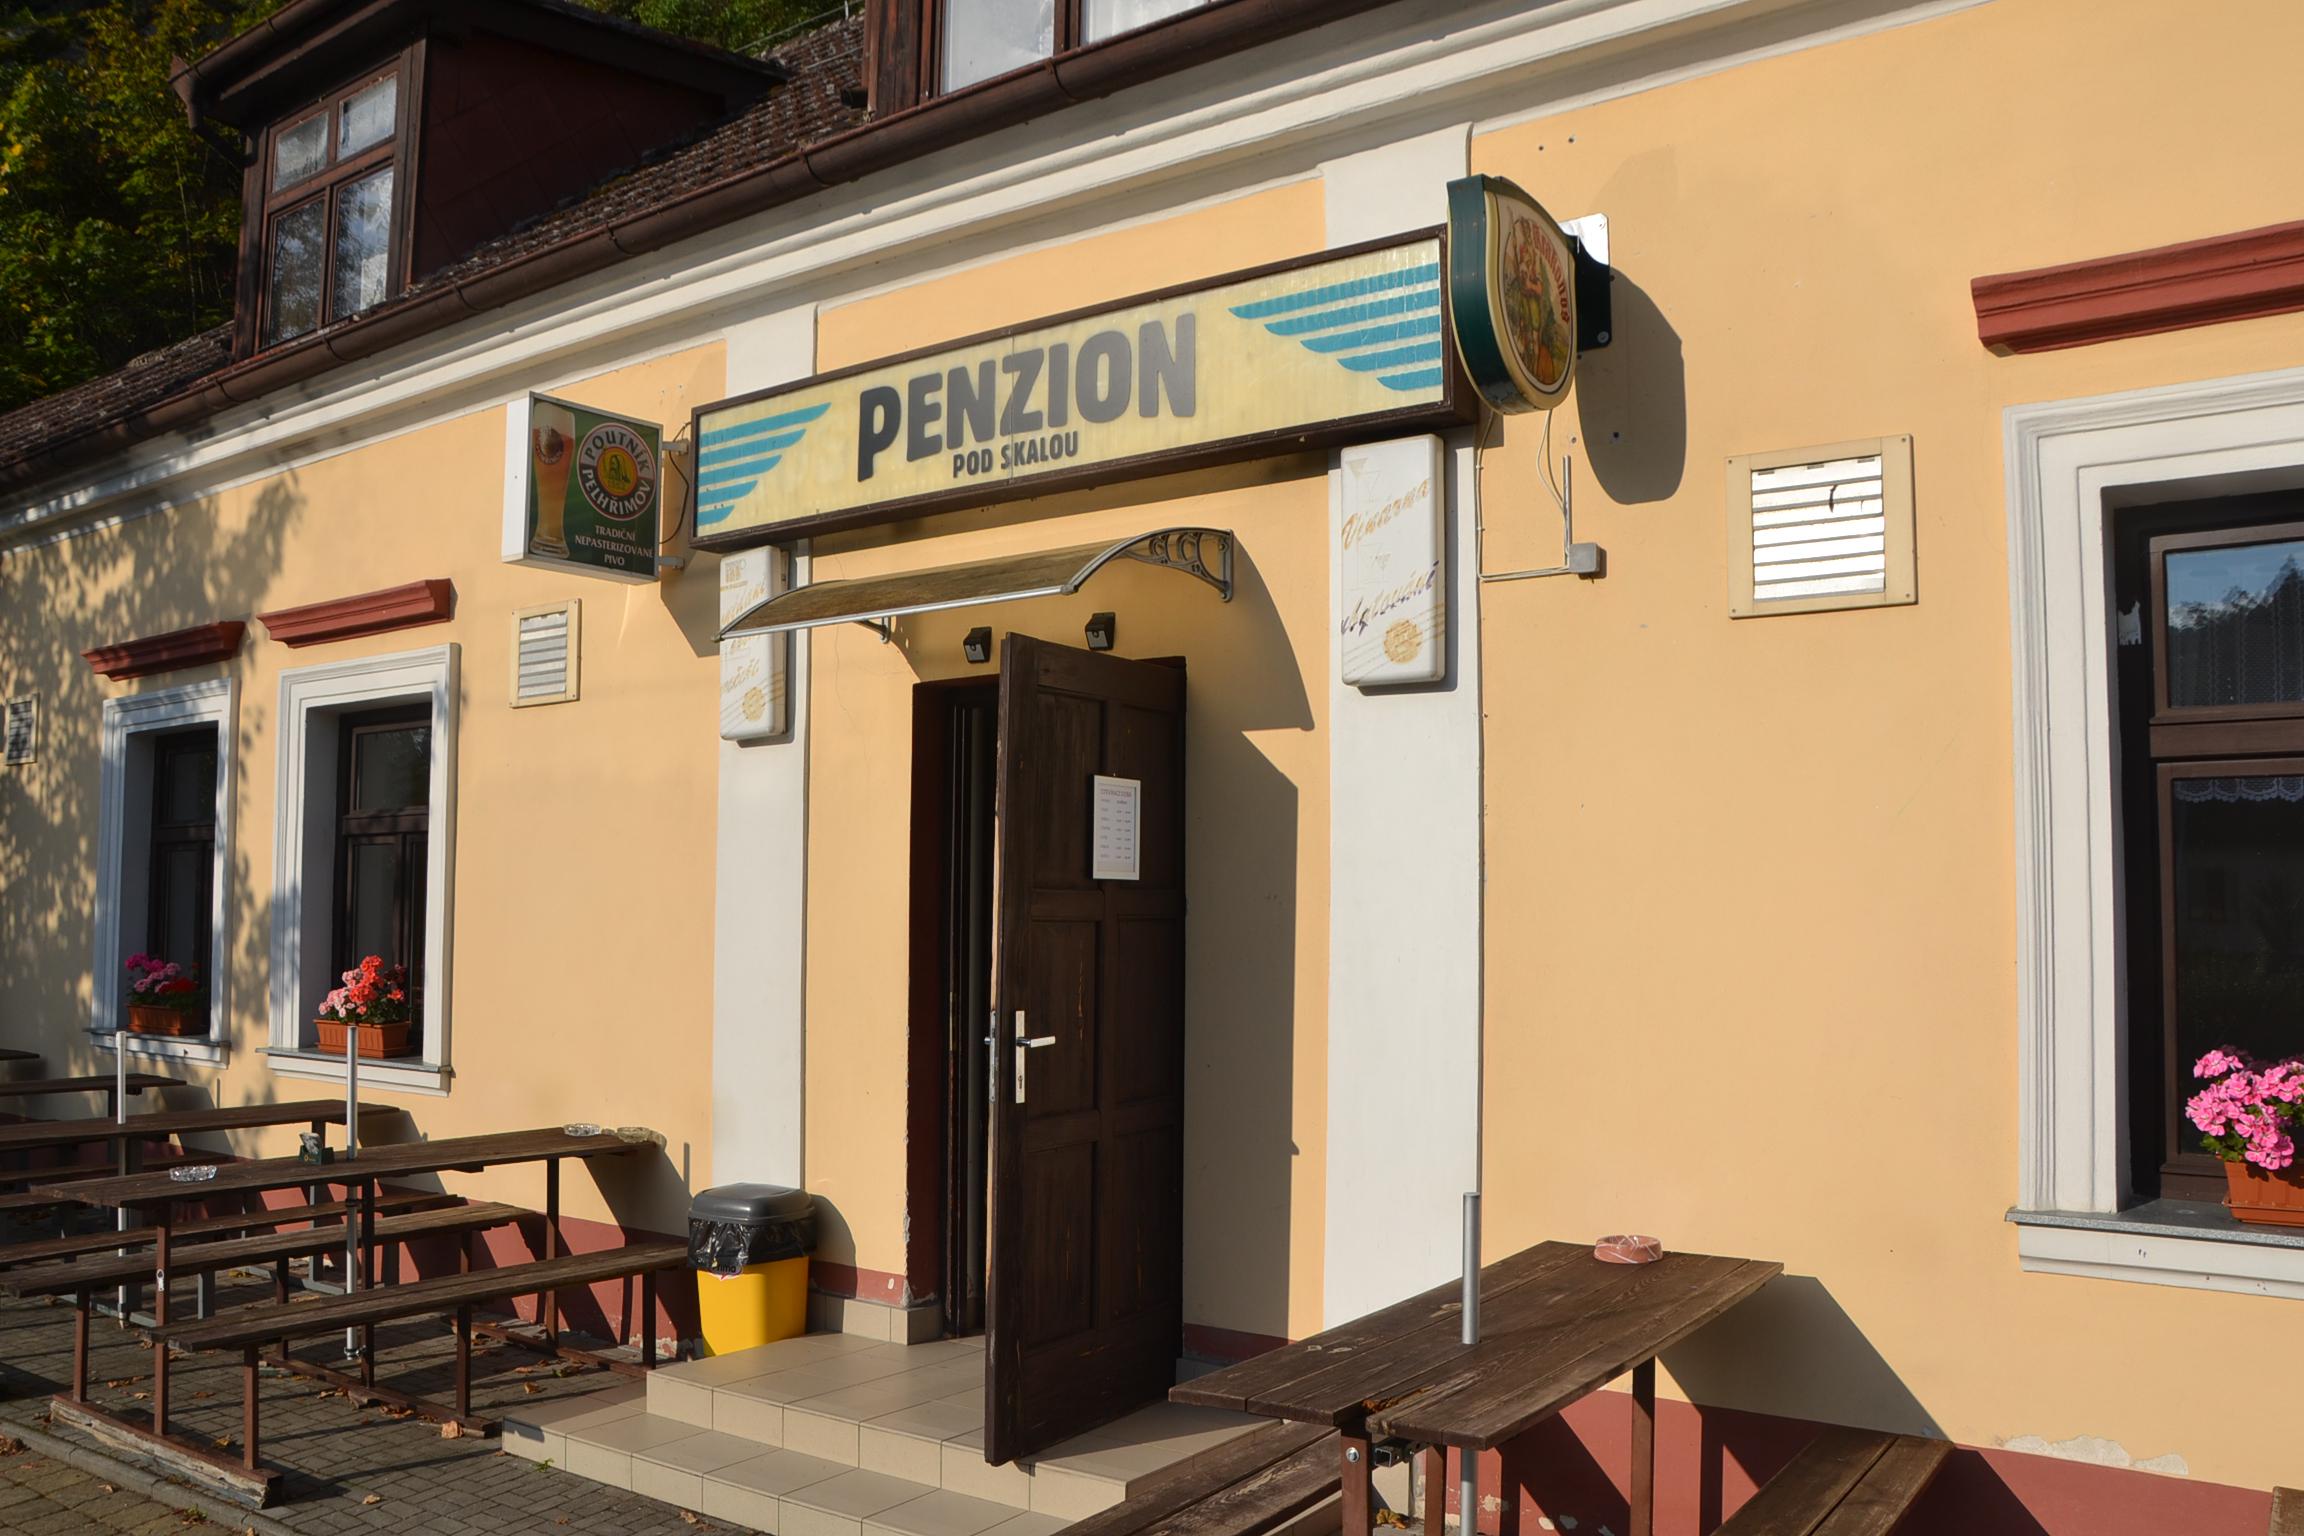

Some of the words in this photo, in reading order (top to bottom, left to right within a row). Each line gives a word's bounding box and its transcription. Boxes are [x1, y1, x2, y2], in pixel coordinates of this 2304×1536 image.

[858, 313, 1196, 482] PENZION
[952, 447, 993, 478] POD
[1000, 430, 1079, 470] SKALOU
[582, 469, 651, 515] PELHŘIMOV
[604, 553, 625, 566] PIVO
